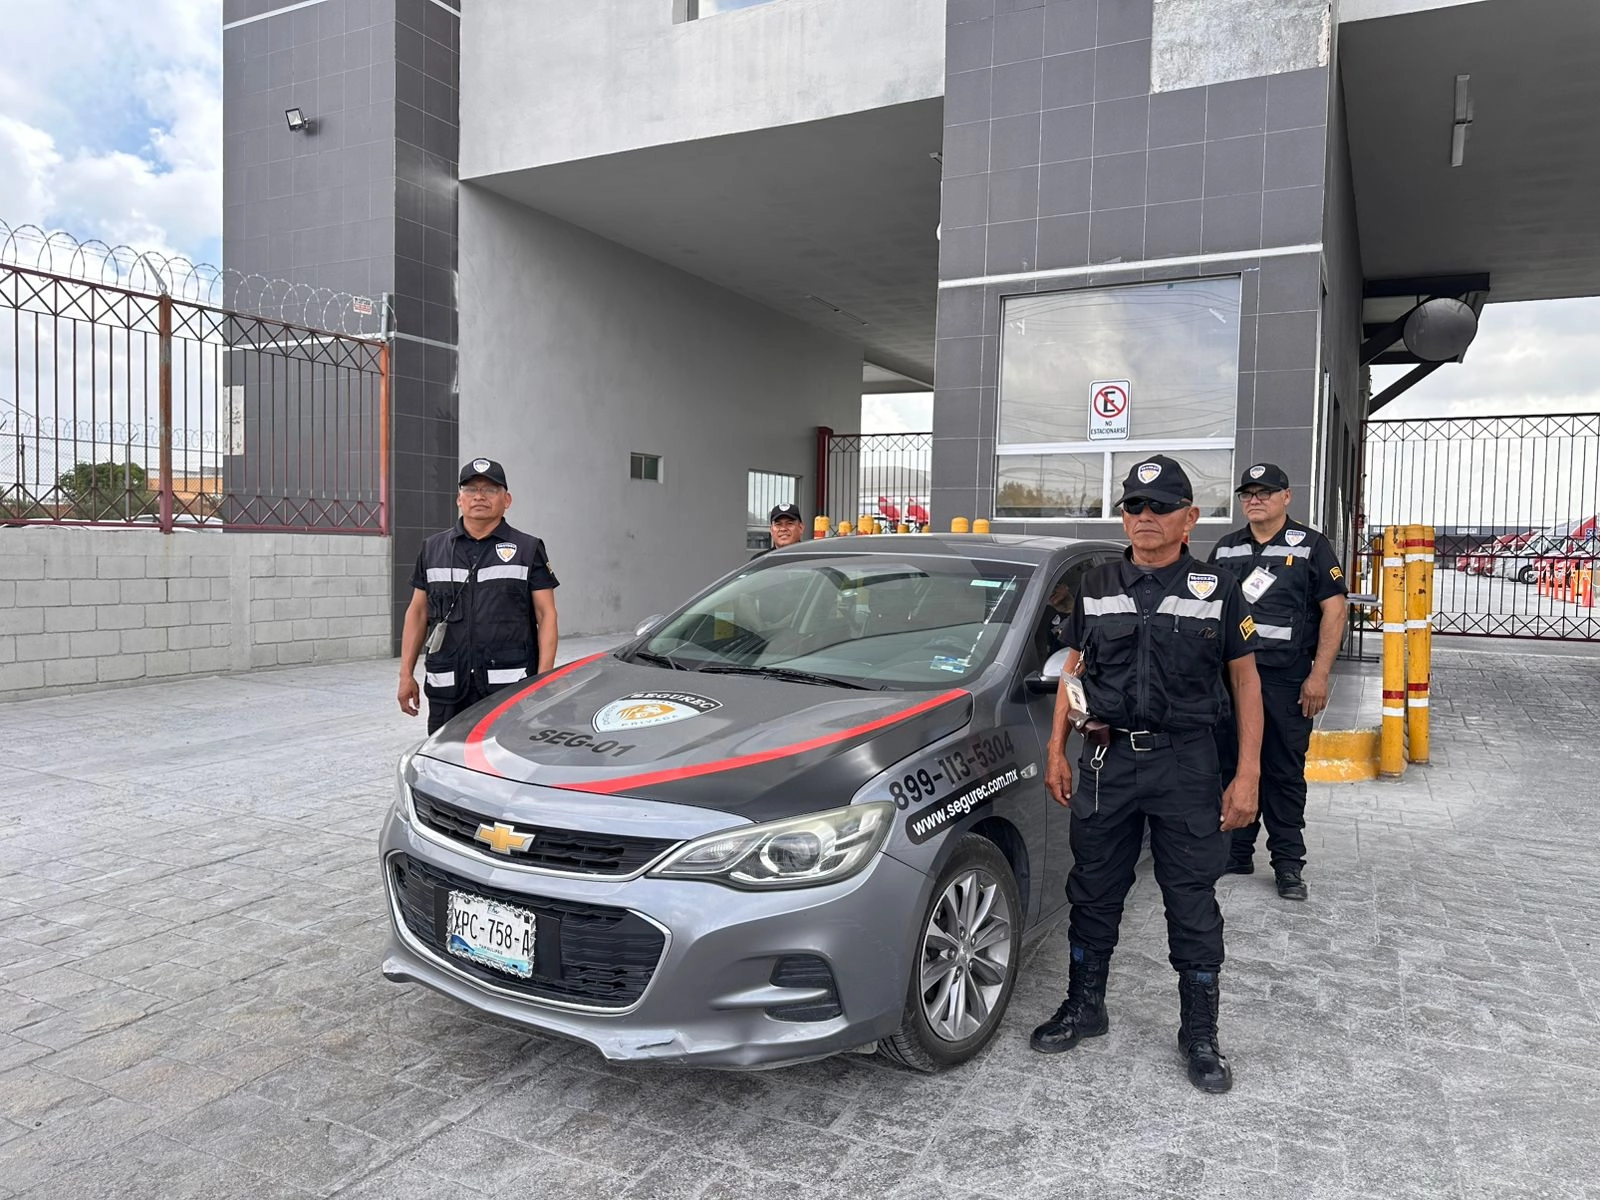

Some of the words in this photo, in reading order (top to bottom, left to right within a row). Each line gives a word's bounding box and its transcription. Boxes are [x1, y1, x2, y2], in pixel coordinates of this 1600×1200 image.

[1103, 391, 1116, 413] E
[630, 693, 716, 709] SEGUREC
[529, 728, 636, 758] SEG-01
[889, 730, 1015, 811] 899-113-5304
[912, 768, 1019, 836] www.segurec.com.mx
[453, 908, 530, 957] XPC-758-A
